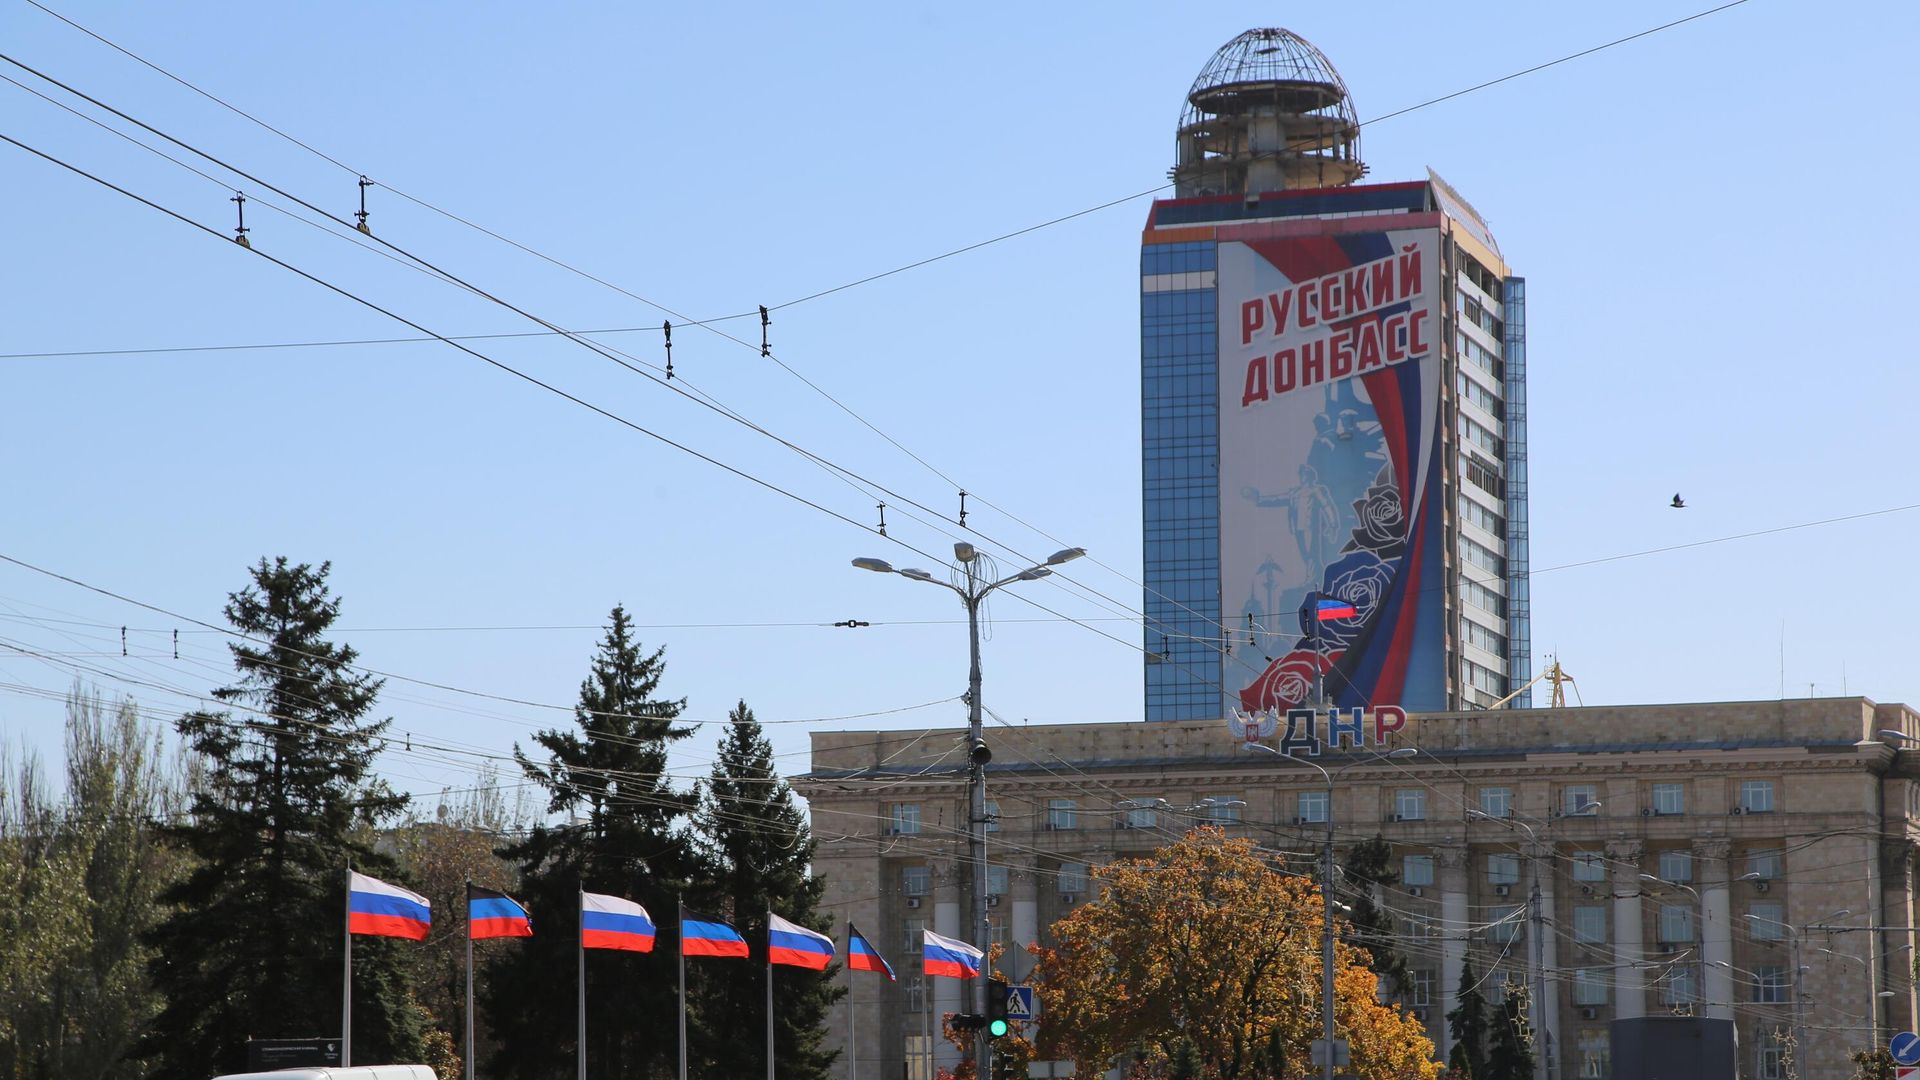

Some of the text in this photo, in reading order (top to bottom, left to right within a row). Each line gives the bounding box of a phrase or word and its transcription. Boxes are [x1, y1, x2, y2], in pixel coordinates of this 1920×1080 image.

[1242, 242, 1422, 345] РУССКИЙ
[1242, 309, 1429, 407] ДОНБАСС
[1279, 705, 1408, 756] ДНР
